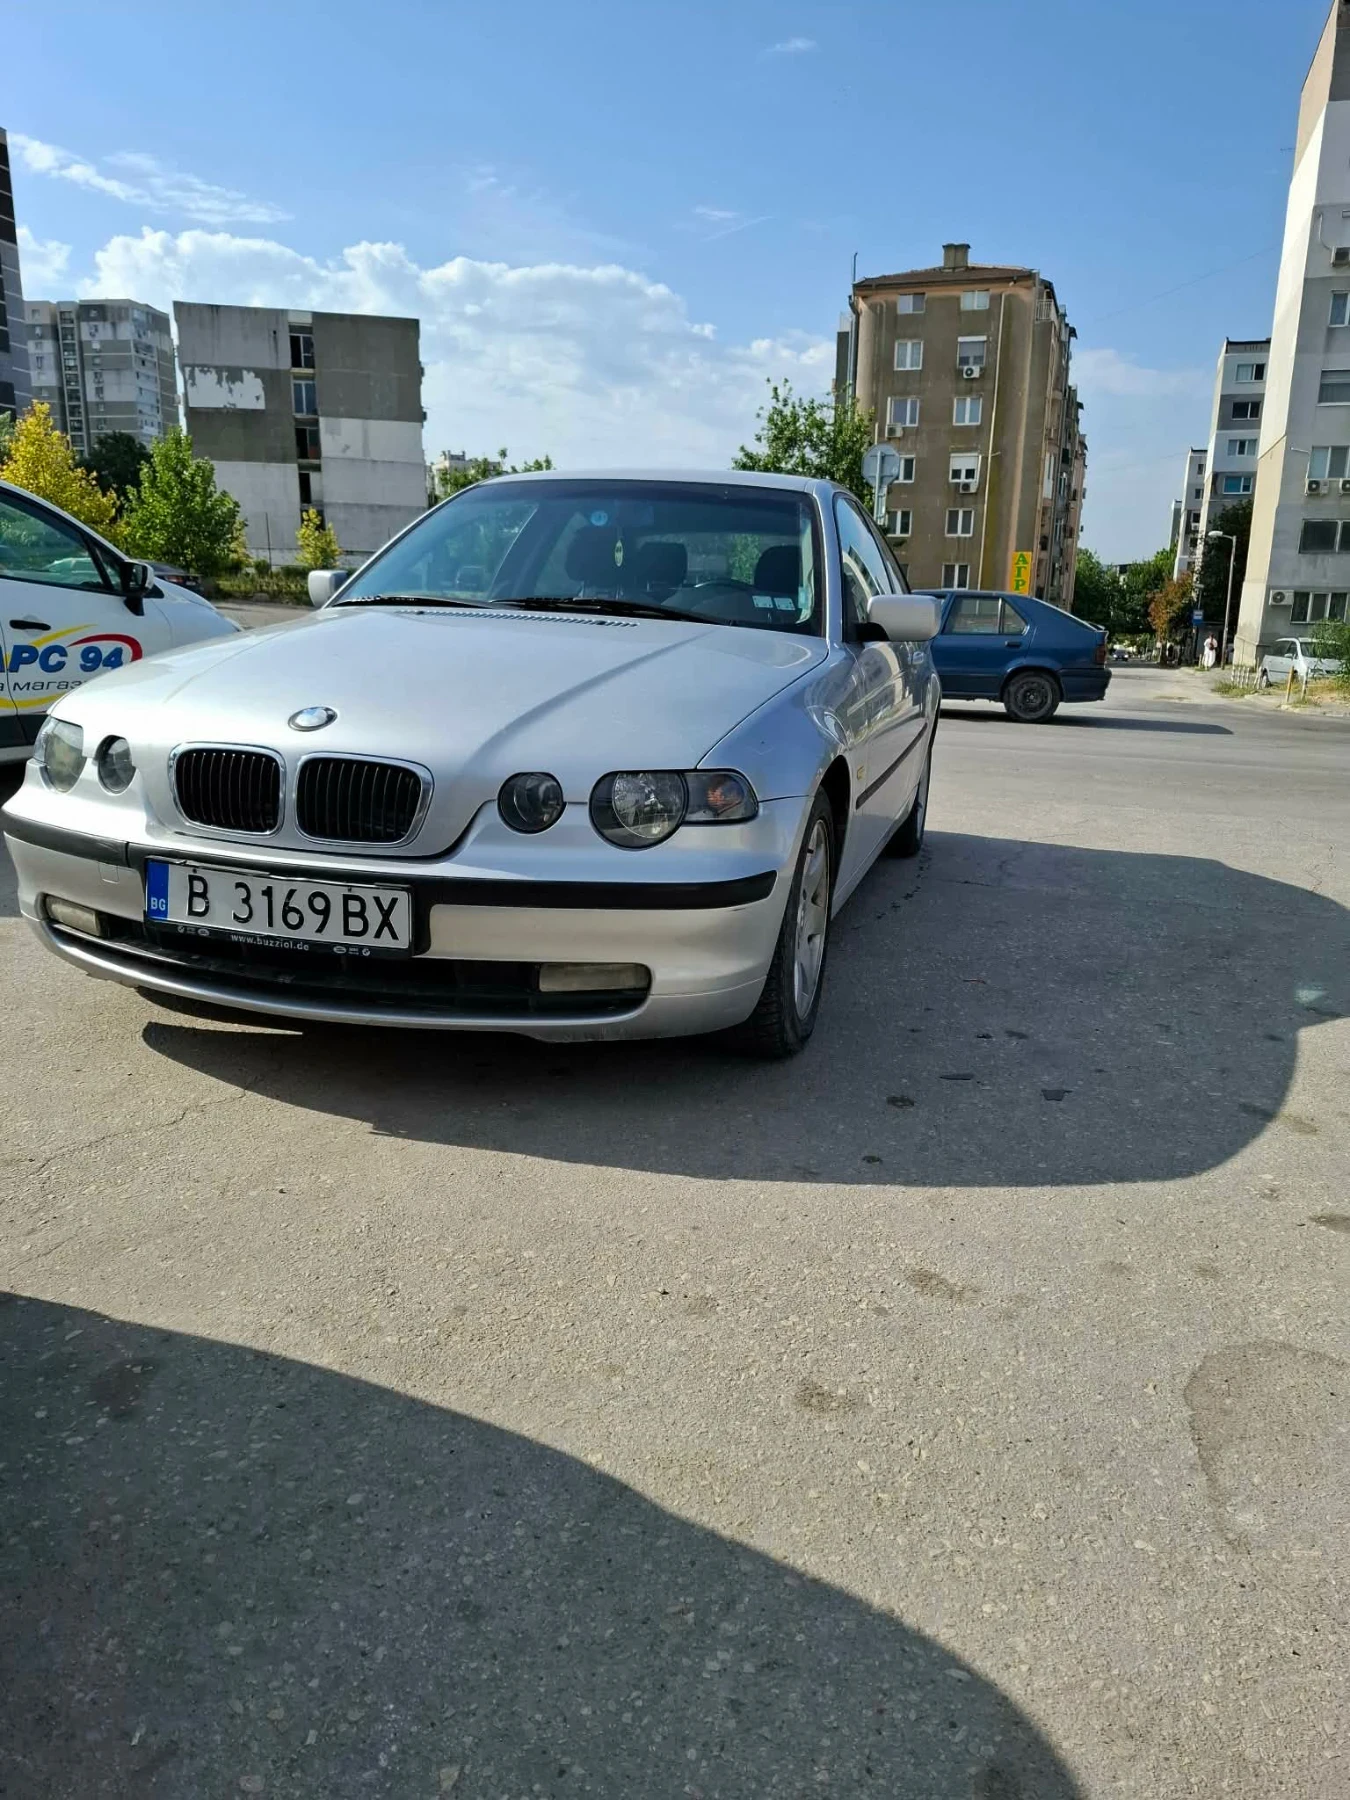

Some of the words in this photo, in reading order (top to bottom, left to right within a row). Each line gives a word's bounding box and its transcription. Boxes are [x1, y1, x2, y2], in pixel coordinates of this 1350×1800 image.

[1014, 553, 1029, 594] АГР
[79, 645, 123, 672] 94
[13, 680, 87, 691] магаз
[150, 897, 166, 911] BG
